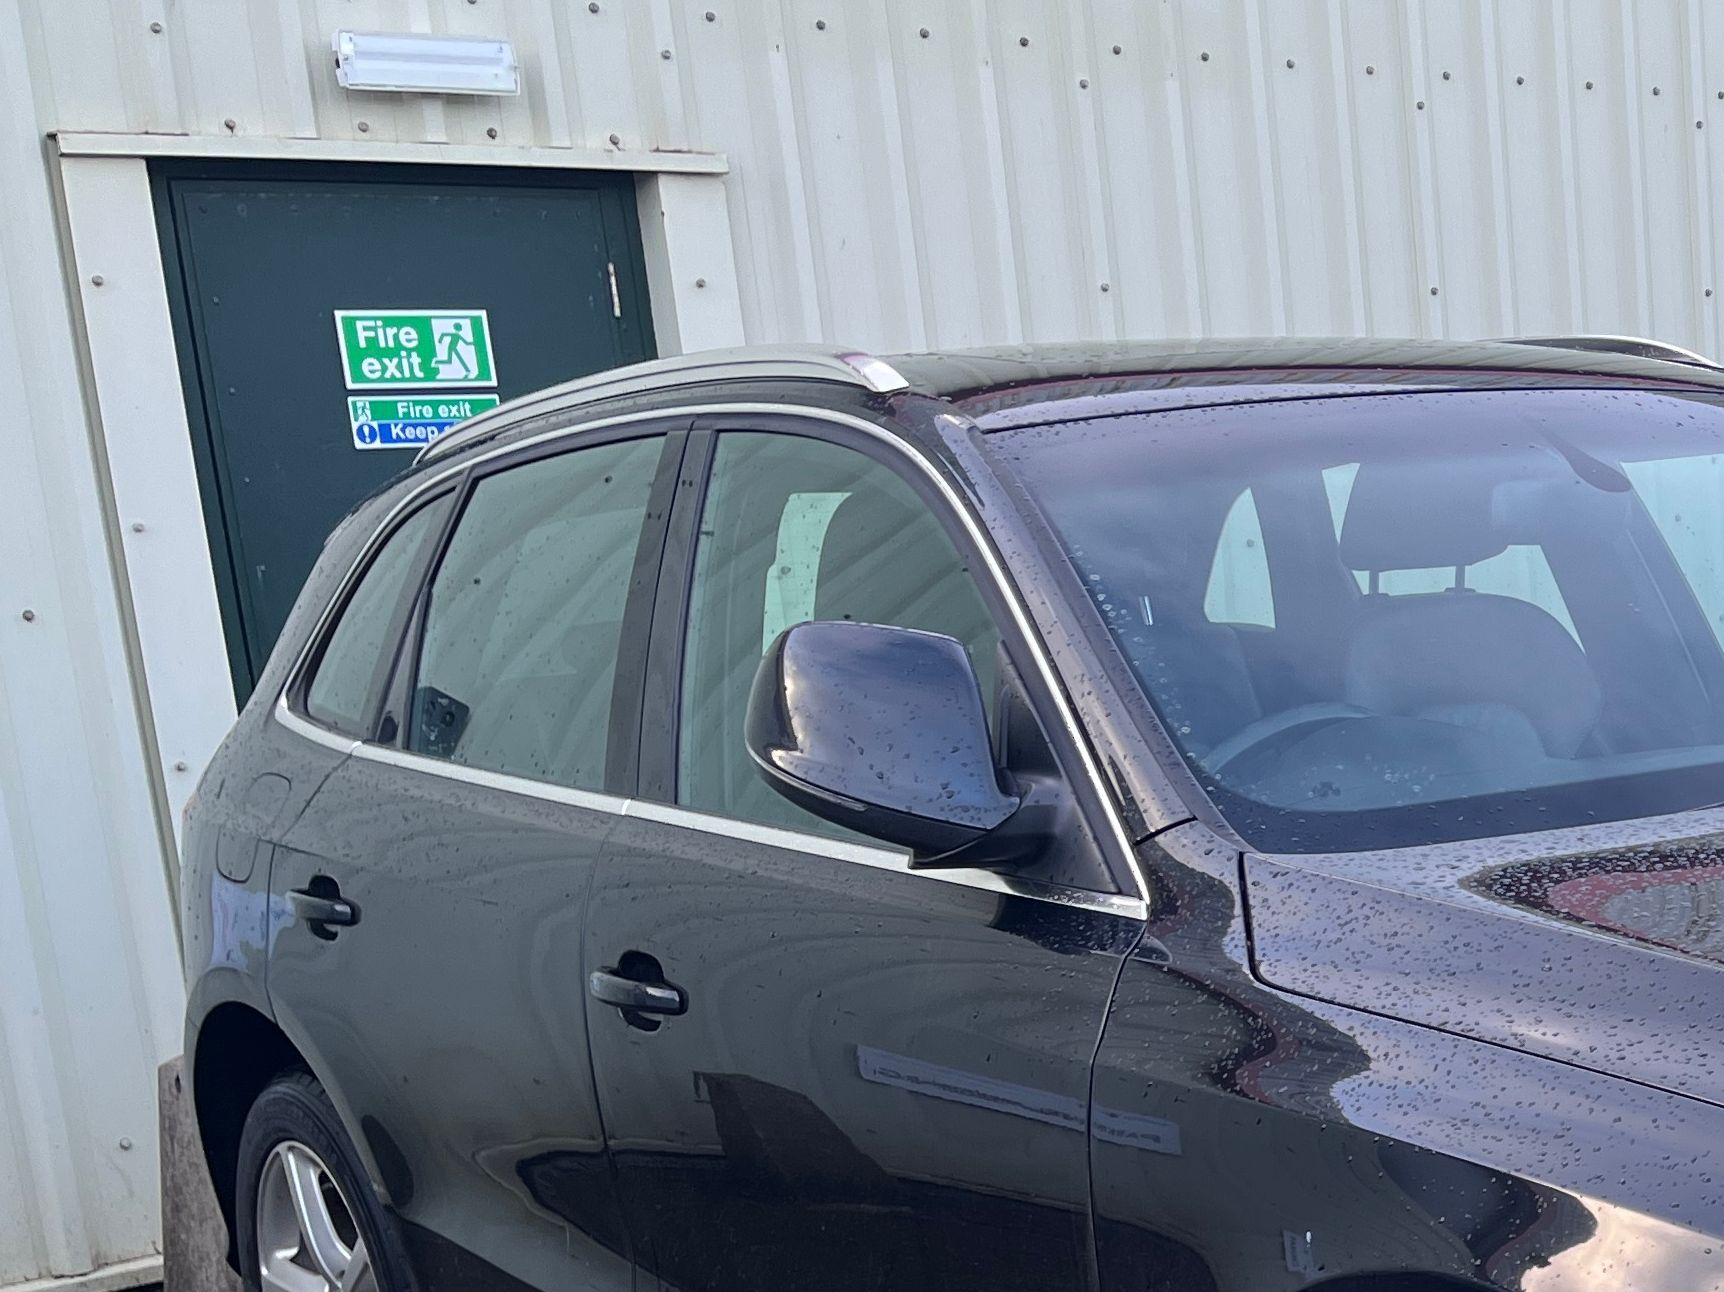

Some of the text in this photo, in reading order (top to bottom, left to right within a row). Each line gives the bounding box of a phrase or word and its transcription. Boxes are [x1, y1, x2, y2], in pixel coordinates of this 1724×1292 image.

[355, 320, 419, 348] Fire
[361, 351, 425, 379] exit
[397, 400, 472, 418] Fire exit
[390, 423, 439, 442] Keep
